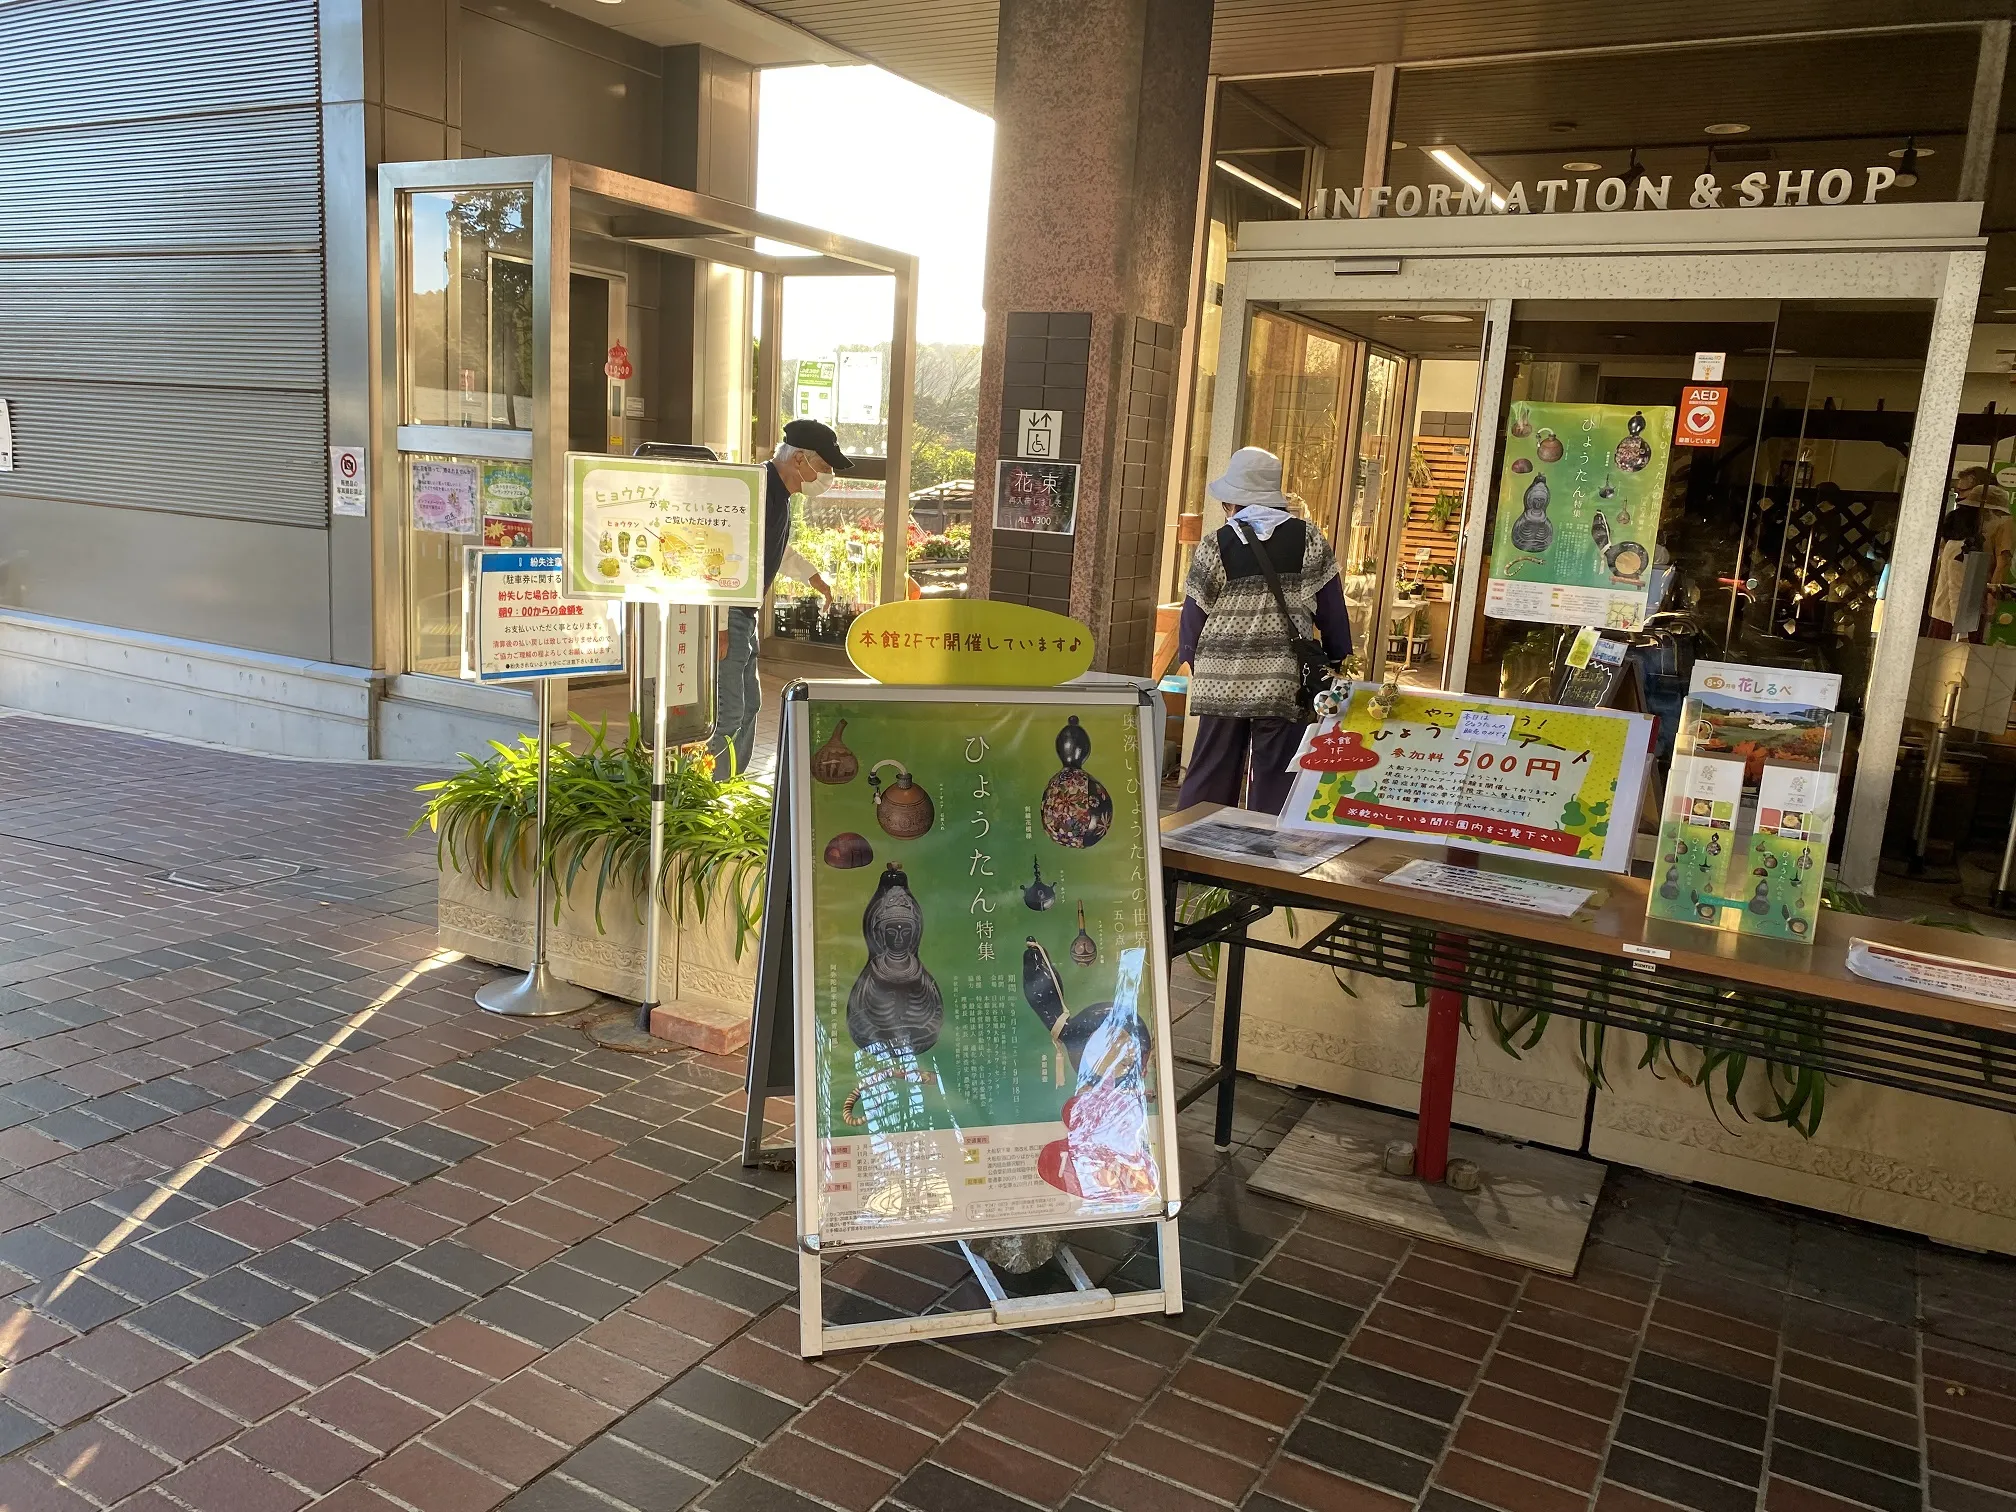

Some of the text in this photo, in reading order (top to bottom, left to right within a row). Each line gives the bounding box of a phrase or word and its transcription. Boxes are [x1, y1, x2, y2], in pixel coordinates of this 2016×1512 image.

[1315, 166, 1896, 219] INFORMATION & SHOP
[1690, 389, 1719, 400] AED
[1015, 472, 1059, 495] 花束
[595, 486, 660, 503] ヒョウタン
[607, 519, 639, 528] ヒョウタン
[665, 516, 732, 527] ご覧いただけます。
[1031, 516, 1051, 526] ¥300
[1738, 677, 1792, 696] 花しるべ
[1424, 707, 1548, 730] やっう！
[1323, 736, 1351, 746] 本館
[1369, 722, 1591, 765] ひょうアート
[1330, 746, 1344, 755] 1F
[1305, 756, 1374, 765] インフォメーション
[1391, 747, 1561, 781] 参加料 500円
